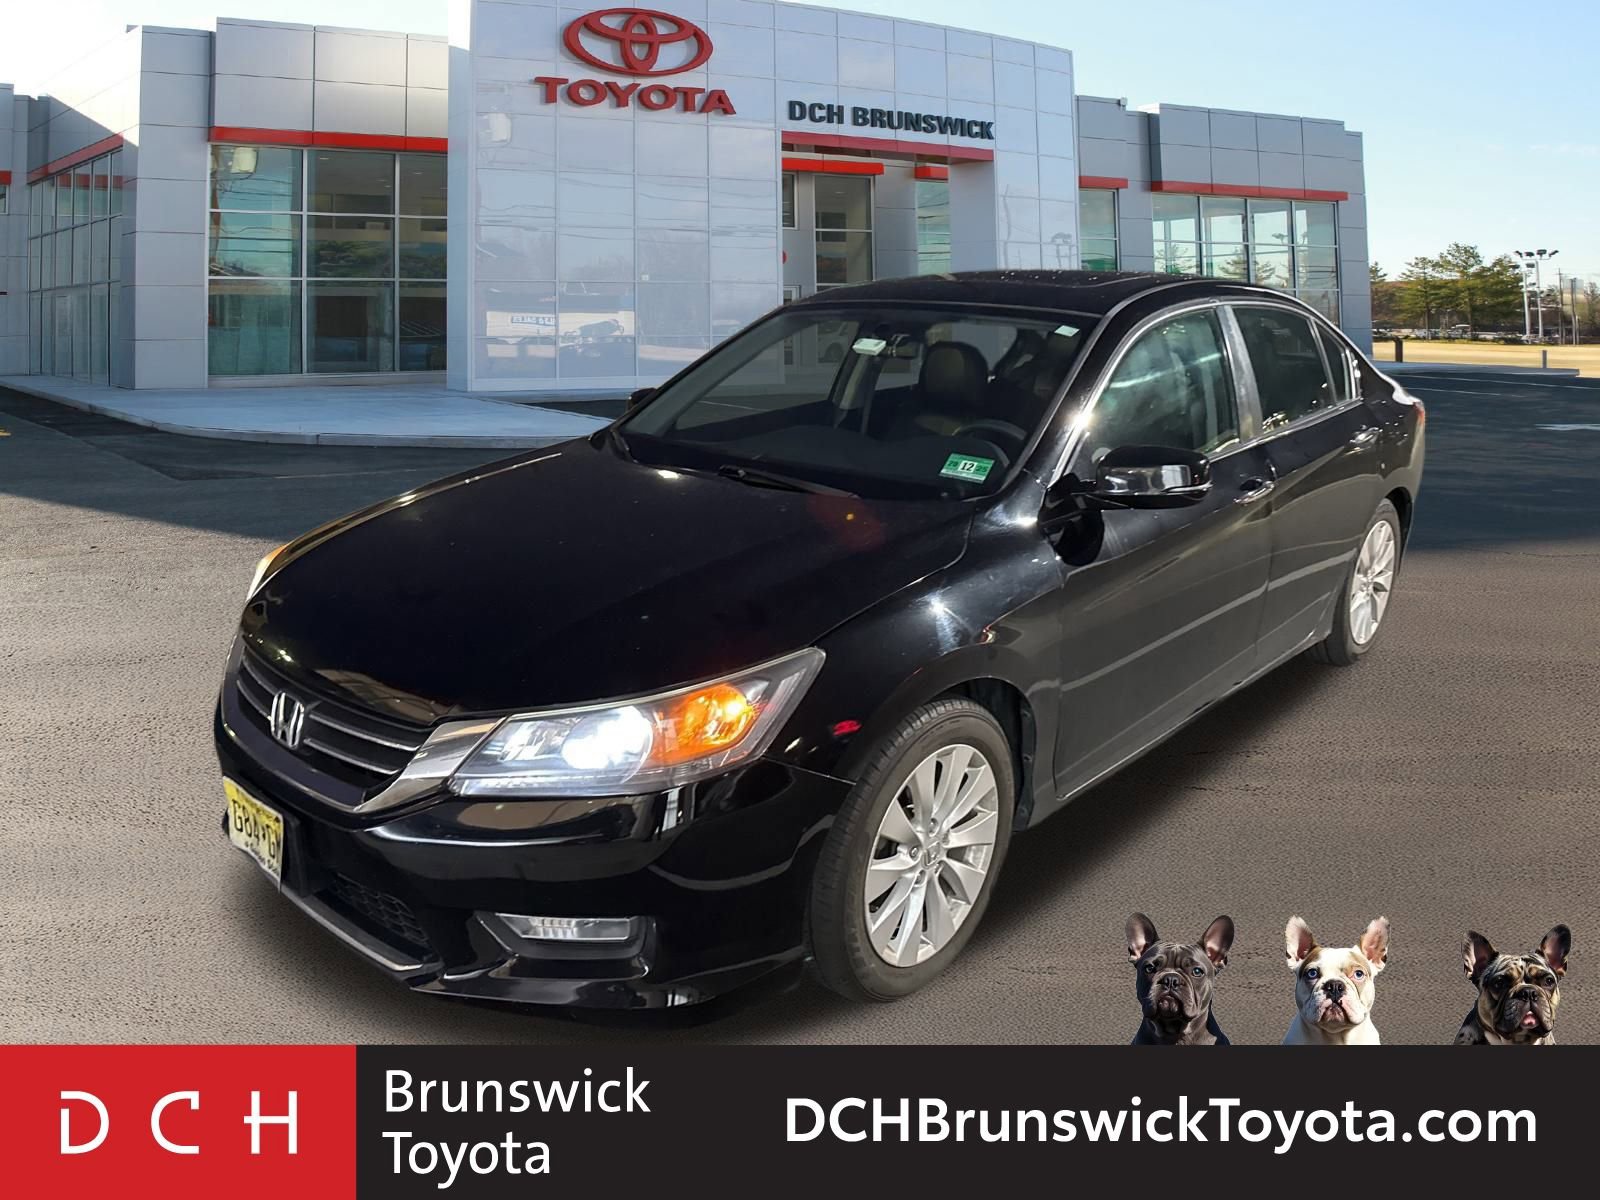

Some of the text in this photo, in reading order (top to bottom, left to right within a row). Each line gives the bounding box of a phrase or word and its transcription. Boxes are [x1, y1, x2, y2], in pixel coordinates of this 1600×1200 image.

[535, 76, 736, 115] TOYOTA
[788, 100, 995, 140] DCH BRUNSWICK
[960, 462, 975, 472] 12
